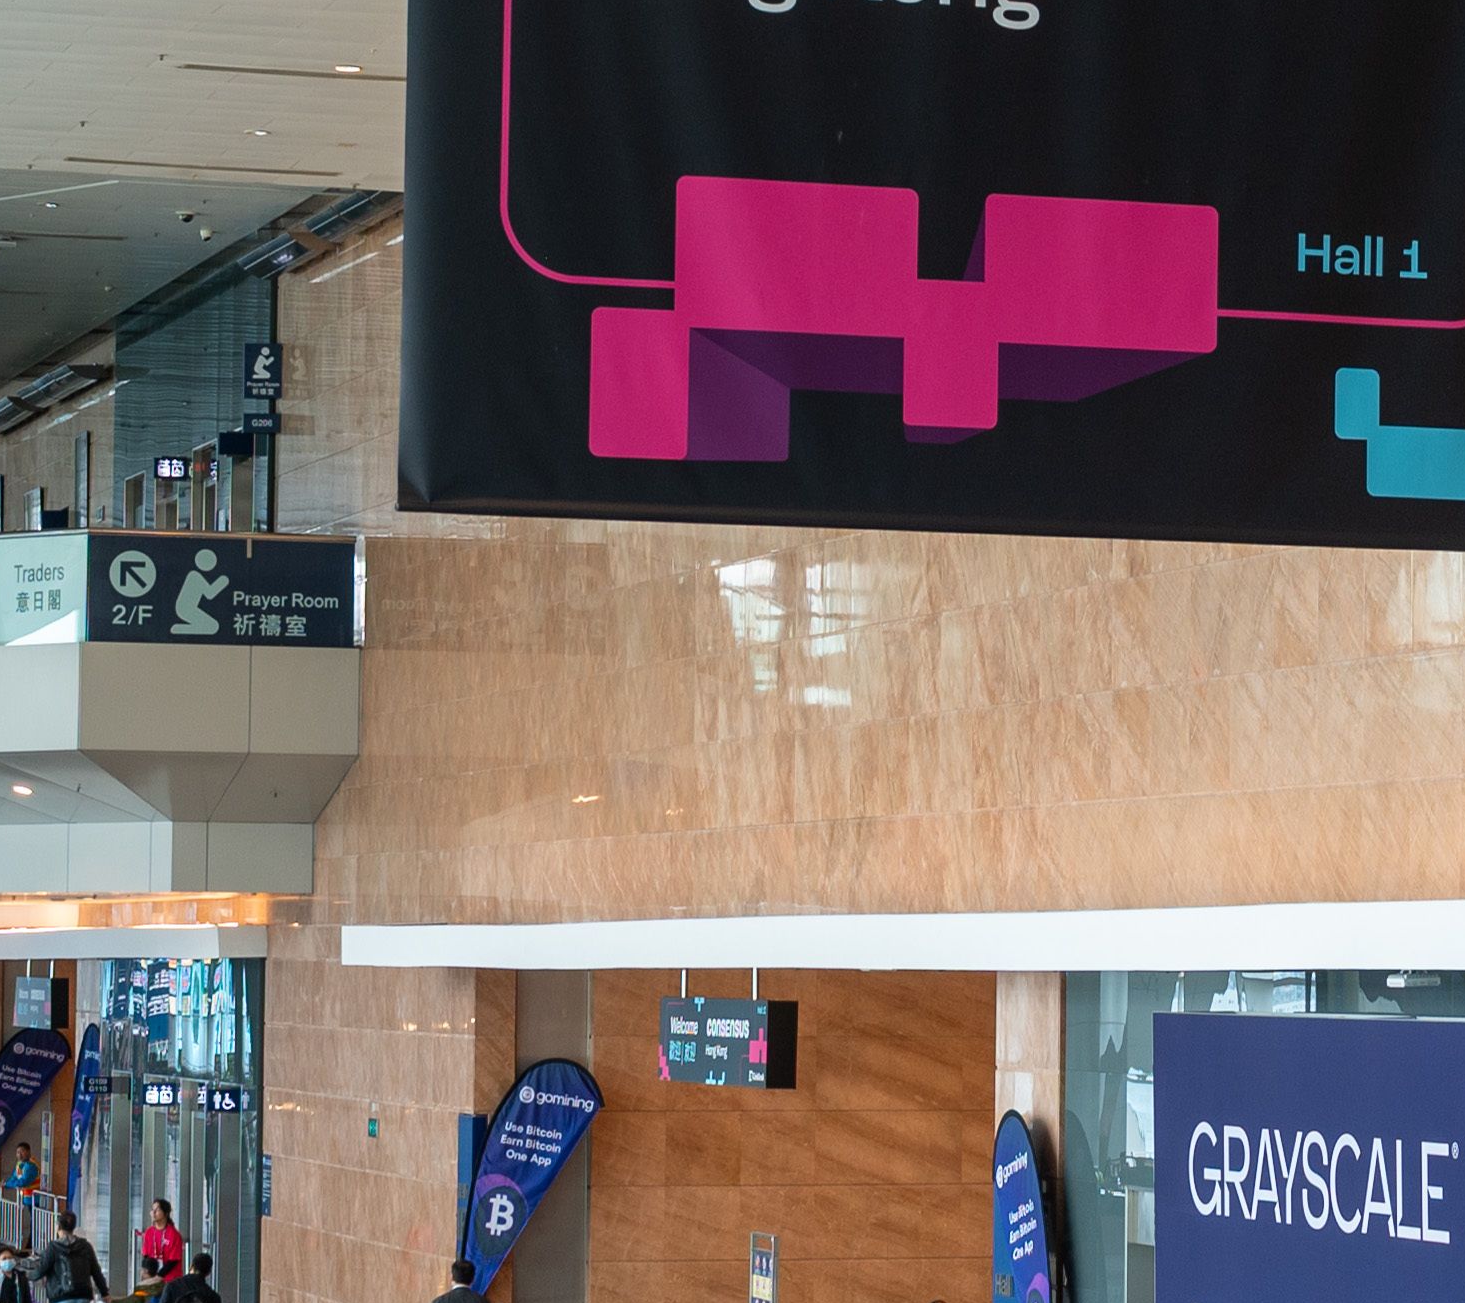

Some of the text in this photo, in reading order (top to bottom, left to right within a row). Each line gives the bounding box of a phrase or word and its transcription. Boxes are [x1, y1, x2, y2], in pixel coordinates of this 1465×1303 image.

[1297, 233, 1428, 281] Hall 1
[14, 563, 65, 584] Traders
[16, 589, 61, 613] 意日閣
[233, 591, 339, 610] Prayer Room
[111, 604, 154, 625] 2/F
[233, 613, 307, 637] 祈禱室
[670, 1016, 699, 1036] Welcome
[706, 1018, 750, 1039] CONSENSUS
[25, 1046, 65, 1063] gomining
[0, 1073, 41, 1087] Earn Bitcoin
[2, 1064, 42, 1080] Use Bitcoin
[1, 1082, 33, 1095] One App
[536, 1092, 594, 1113] gomining
[505, 1121, 562, 1140] Use Bitcoin
[500, 1134, 561, 1153] Earn Bitcoin
[506, 1149, 552, 1167] One App
[1003, 1151, 1028, 1183] gomining
